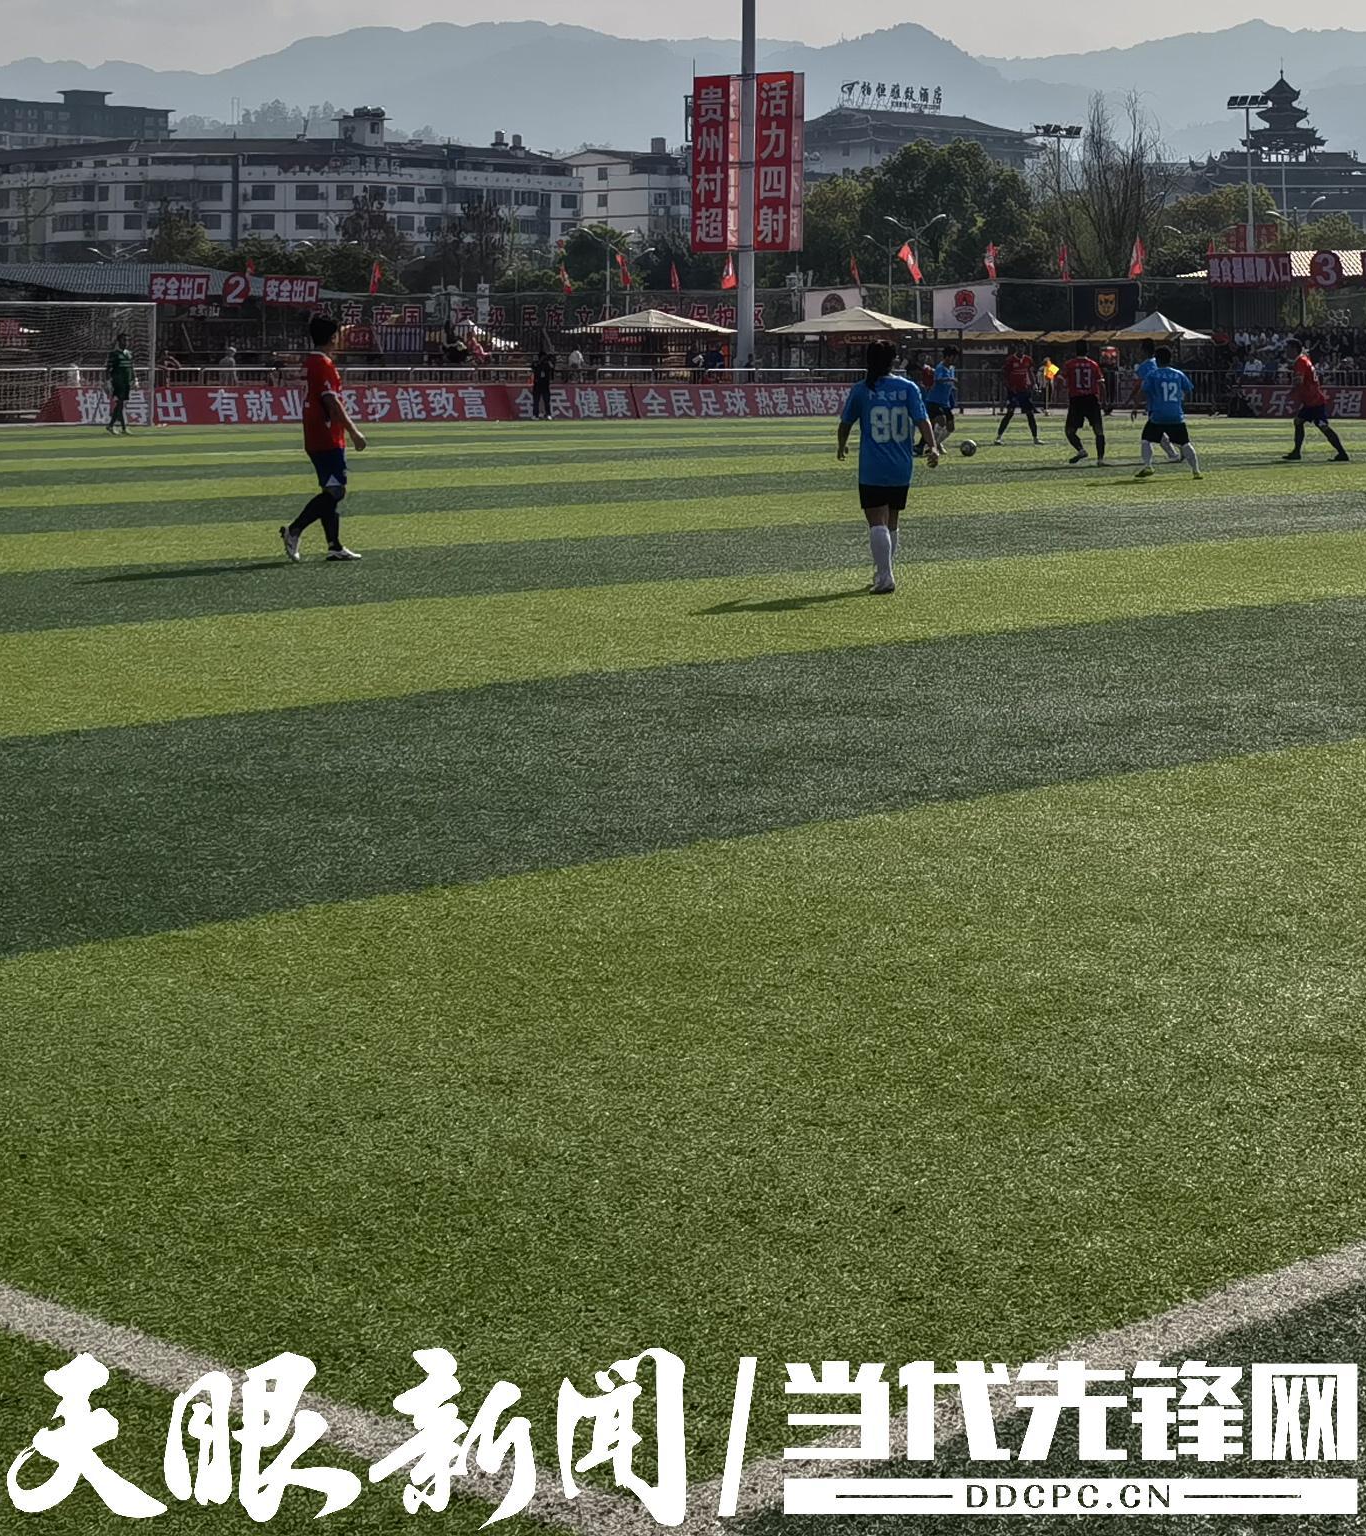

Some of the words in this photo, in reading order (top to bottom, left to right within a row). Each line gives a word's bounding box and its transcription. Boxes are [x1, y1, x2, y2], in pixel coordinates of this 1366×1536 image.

[695, 85, 725, 243] 贵州村超
[757, 80, 788, 244] 活力四射
[1315, 253, 1338, 287] 3
[152, 277, 208, 300] 安全出口
[226, 276, 245, 303] 2
[266, 278, 318, 302] 安全出口
[1075, 368, 1092, 388] 13
[1161, 381, 1179, 402] 12
[642, 388, 749, 417] 全民足球
[870, 406, 908, 444] 80
